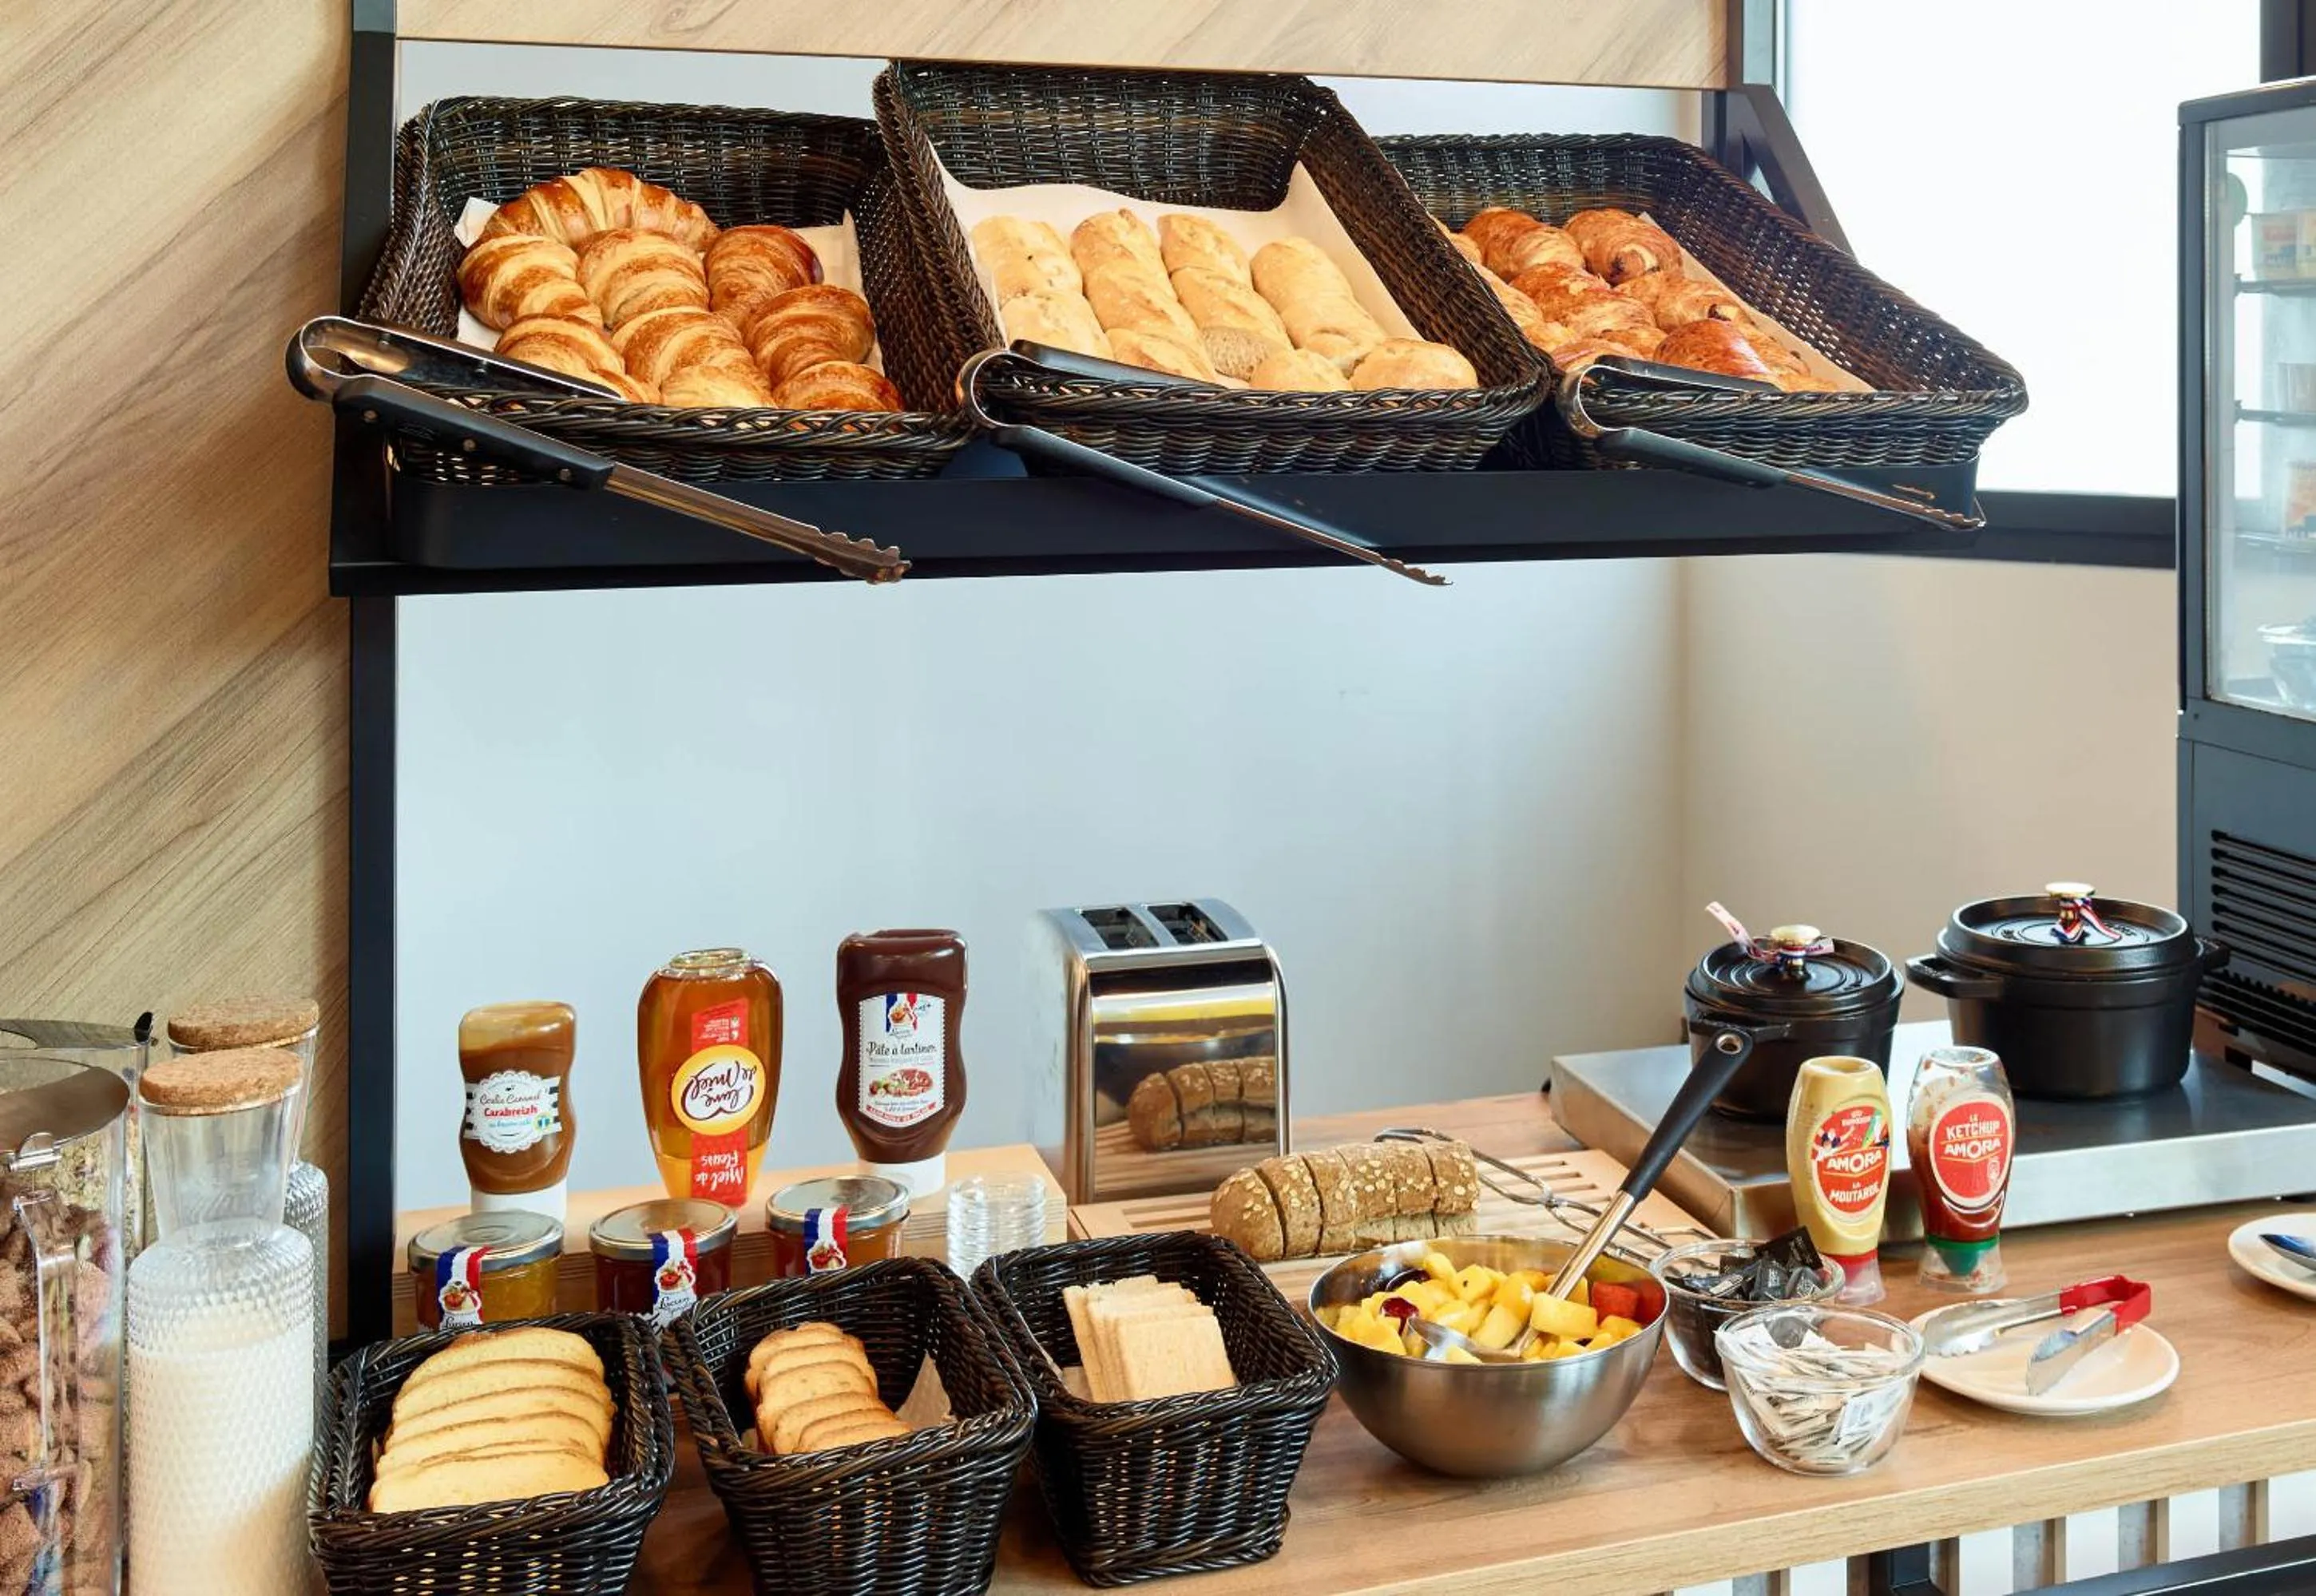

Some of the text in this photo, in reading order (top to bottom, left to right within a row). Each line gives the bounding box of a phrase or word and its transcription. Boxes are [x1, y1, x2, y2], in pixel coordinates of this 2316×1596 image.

[867, 1041, 890, 1055] Pâte
[742, 1065, 757, 1081] de
[484, 1105, 537, 1116] Carabreizh
[1945, 1120, 2001, 1140] KETCHUP
[1944, 1138, 2001, 1158] AMORA
[700, 1150, 738, 1168] Fleurs
[1826, 1150, 1882, 1174] AMORA
[694, 1166, 744, 1191] Miel de
[1830, 1182, 1880, 1203] MOUTARDE
